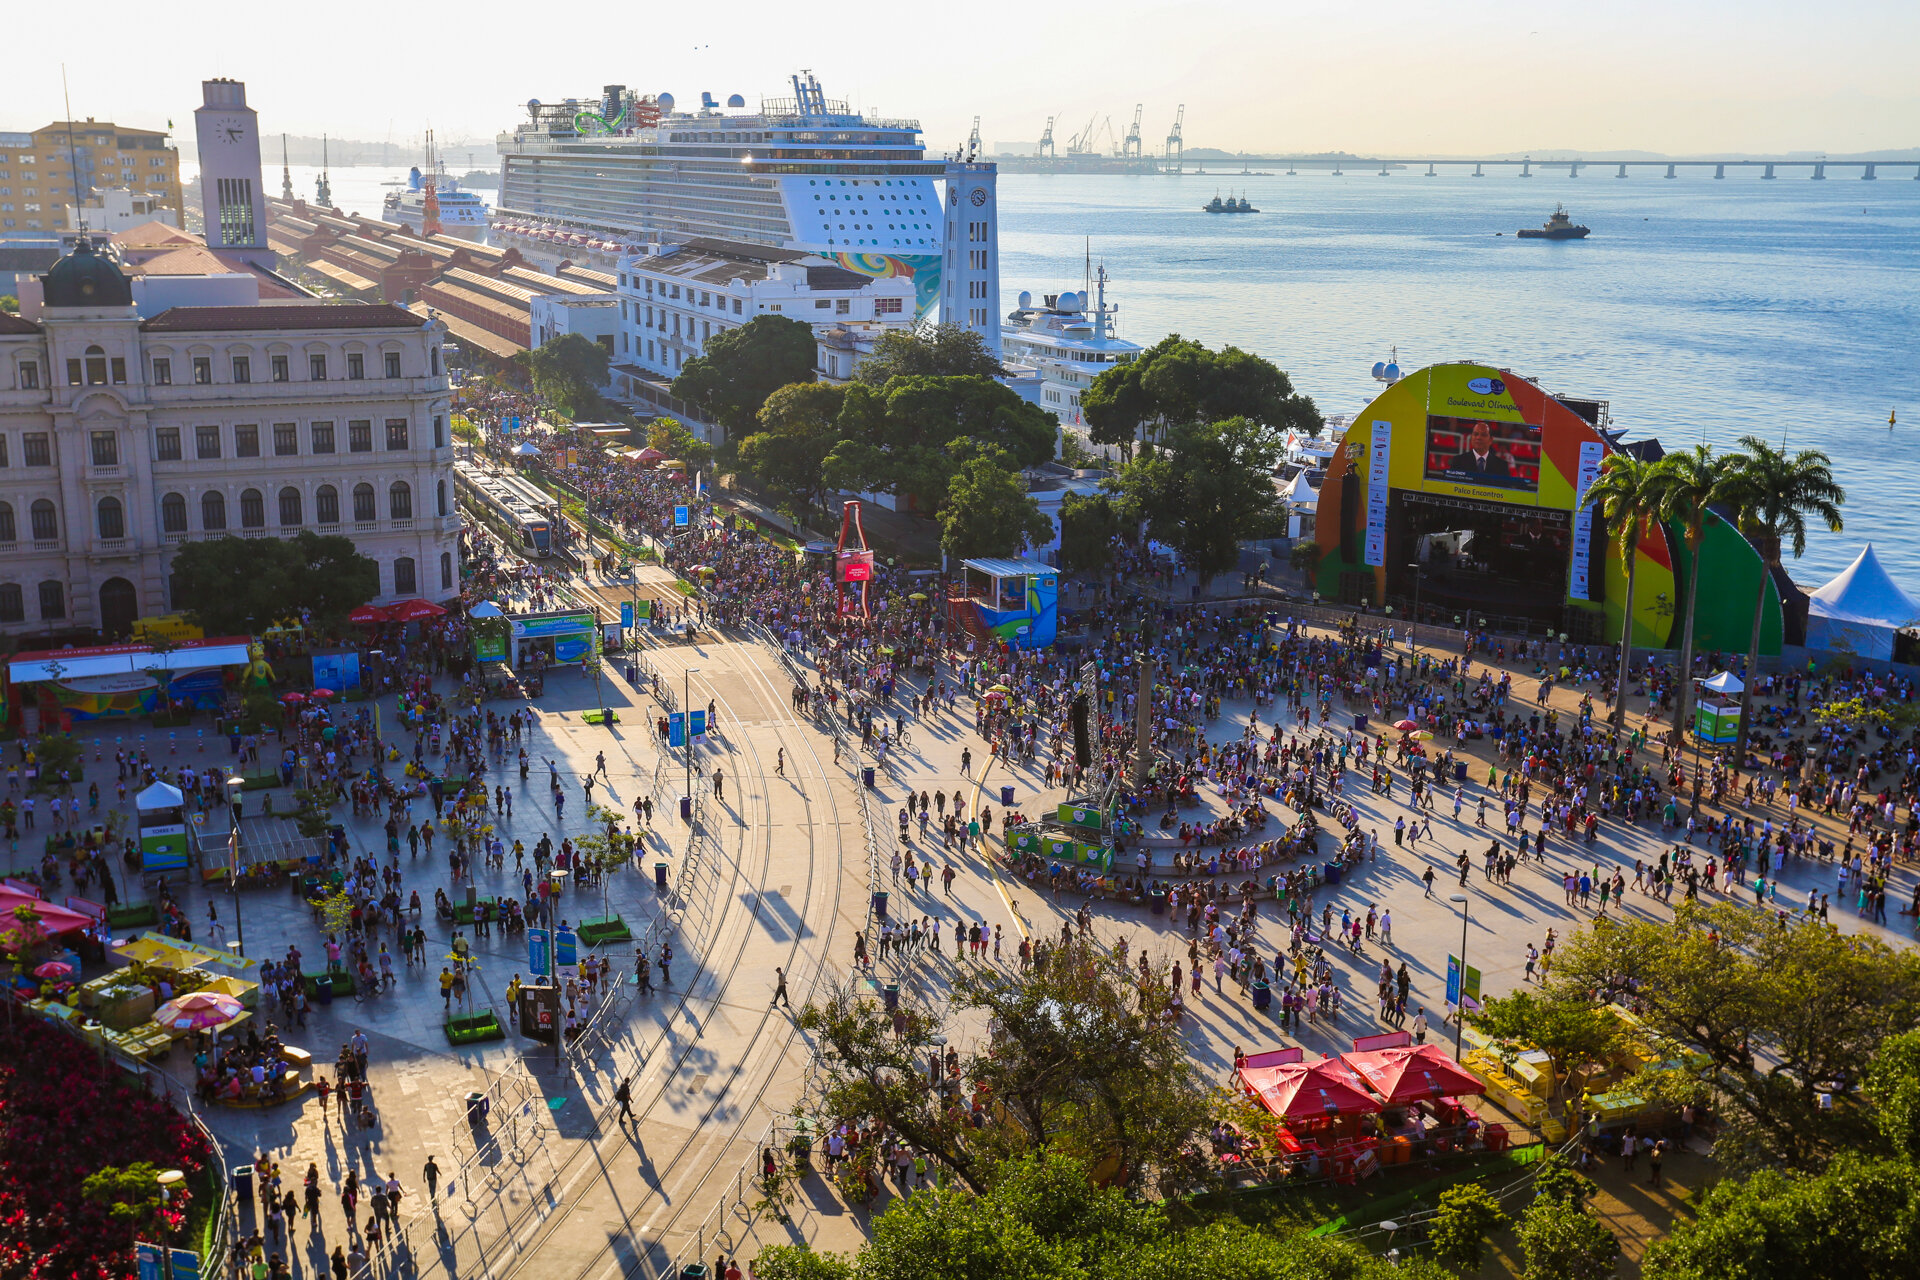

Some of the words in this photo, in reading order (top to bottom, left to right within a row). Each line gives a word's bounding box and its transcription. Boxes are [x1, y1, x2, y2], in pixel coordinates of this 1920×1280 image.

[1447, 396, 1485, 408] Boulevard
[1454, 486, 1471, 495] Palco
[1472, 488, 1504, 499] Encontros
